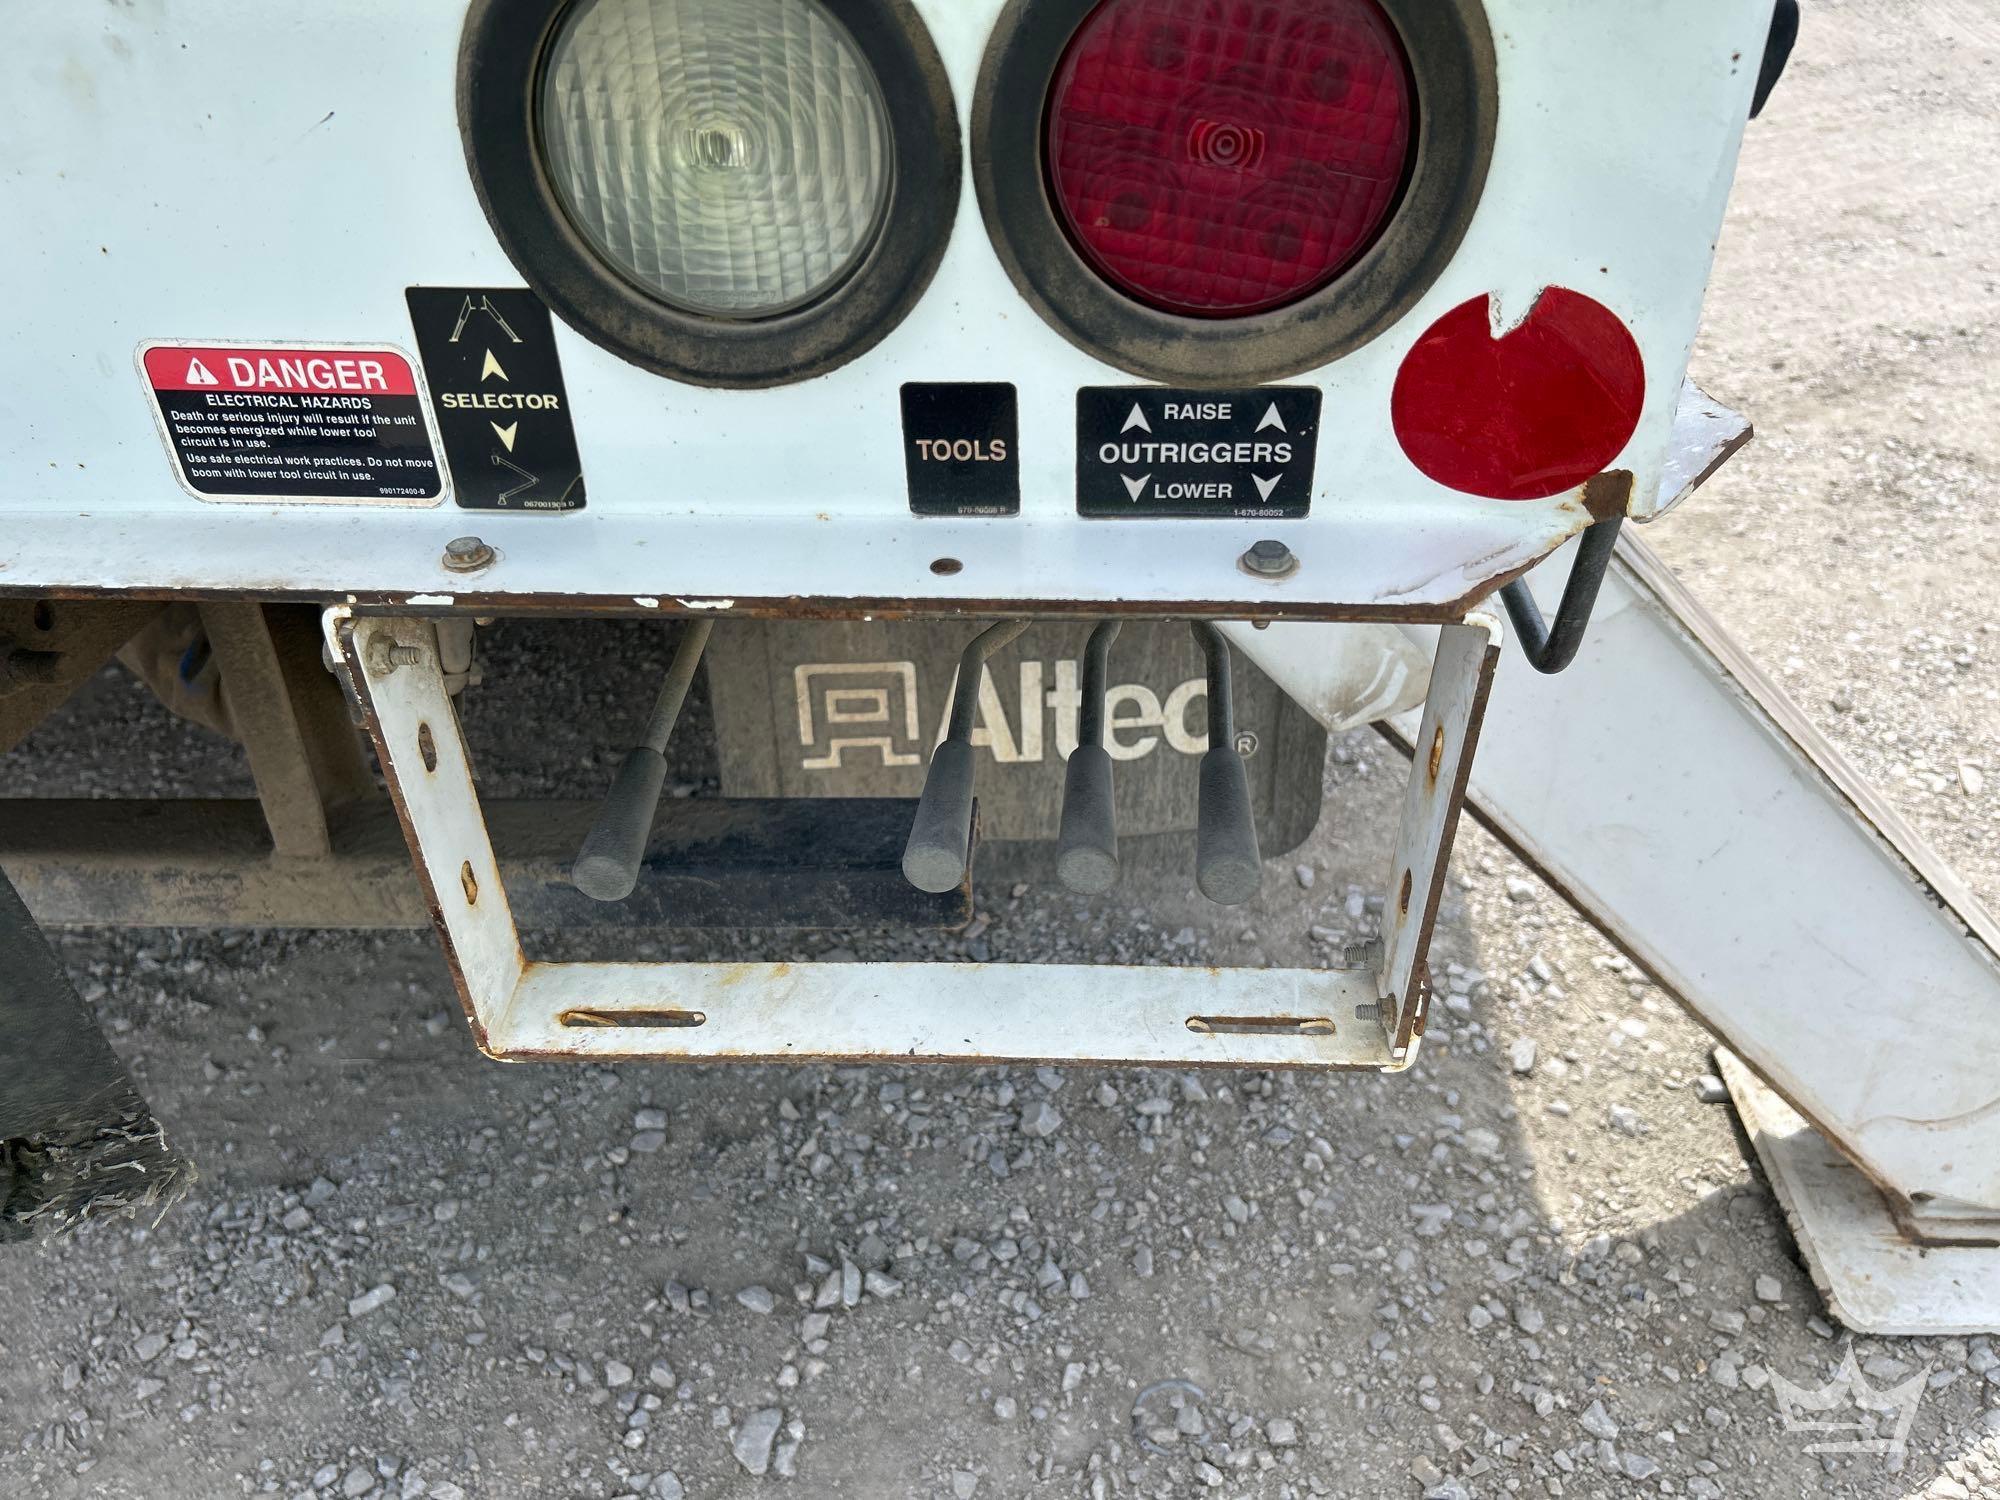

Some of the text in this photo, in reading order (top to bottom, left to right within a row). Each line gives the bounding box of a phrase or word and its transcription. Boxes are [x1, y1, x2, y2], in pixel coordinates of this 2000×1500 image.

[227, 357, 388, 390] DANGER
[206, 394, 372, 410] ELECTRICAL HAZARDS
[441, 392, 559, 410] SELECTOR
[171, 410, 204, 420] Death
[222, 412, 264, 422] serious
[267, 412, 300, 425] injury
[303, 414, 323, 424] will
[326, 414, 359, 424] result
[362, 414, 370, 424] if
[372, 415, 390, 424] the
[394, 416, 416, 425] unit
[1164, 403, 1232, 420] RAISE
[176, 424, 376, 437] becomes energized while lower tool
[181, 437, 270, 448] circuit is in use.
[916, 439, 1007, 462] TOOLS
[186, 453, 433, 468] Use safe electrical work practices. Do not move
[1099, 442, 1292, 464] OUTRIGGERS
[192, 468, 374, 480] boom with lower tool circuit in use.
[1154, 484, 1232, 499] LOWER
[929, 660, 1210, 762] Altec
